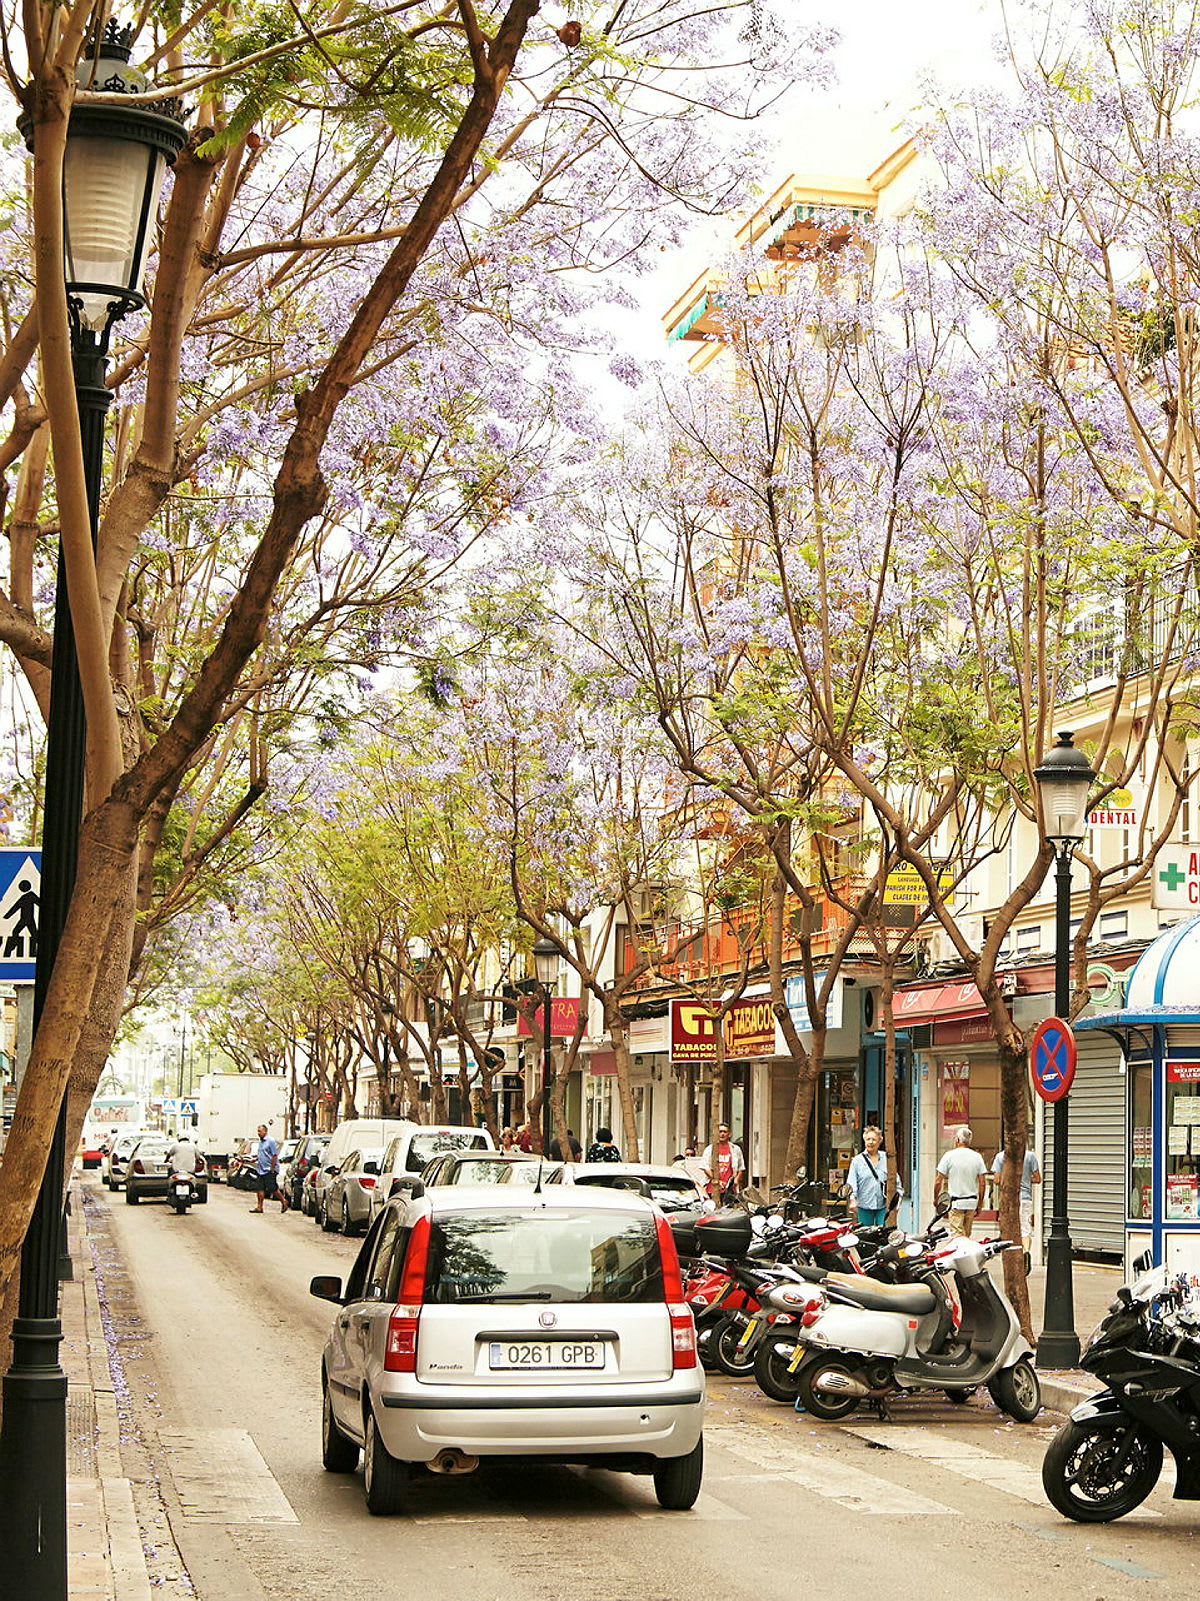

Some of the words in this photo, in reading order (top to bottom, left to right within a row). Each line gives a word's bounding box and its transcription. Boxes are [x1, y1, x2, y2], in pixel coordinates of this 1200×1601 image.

[1091, 812, 1137, 824] DENTAL
[733, 1003, 776, 1035] TABACOS
[508, 1346, 552, 1364] 0261
[561, 1346, 596, 1364] GPB
